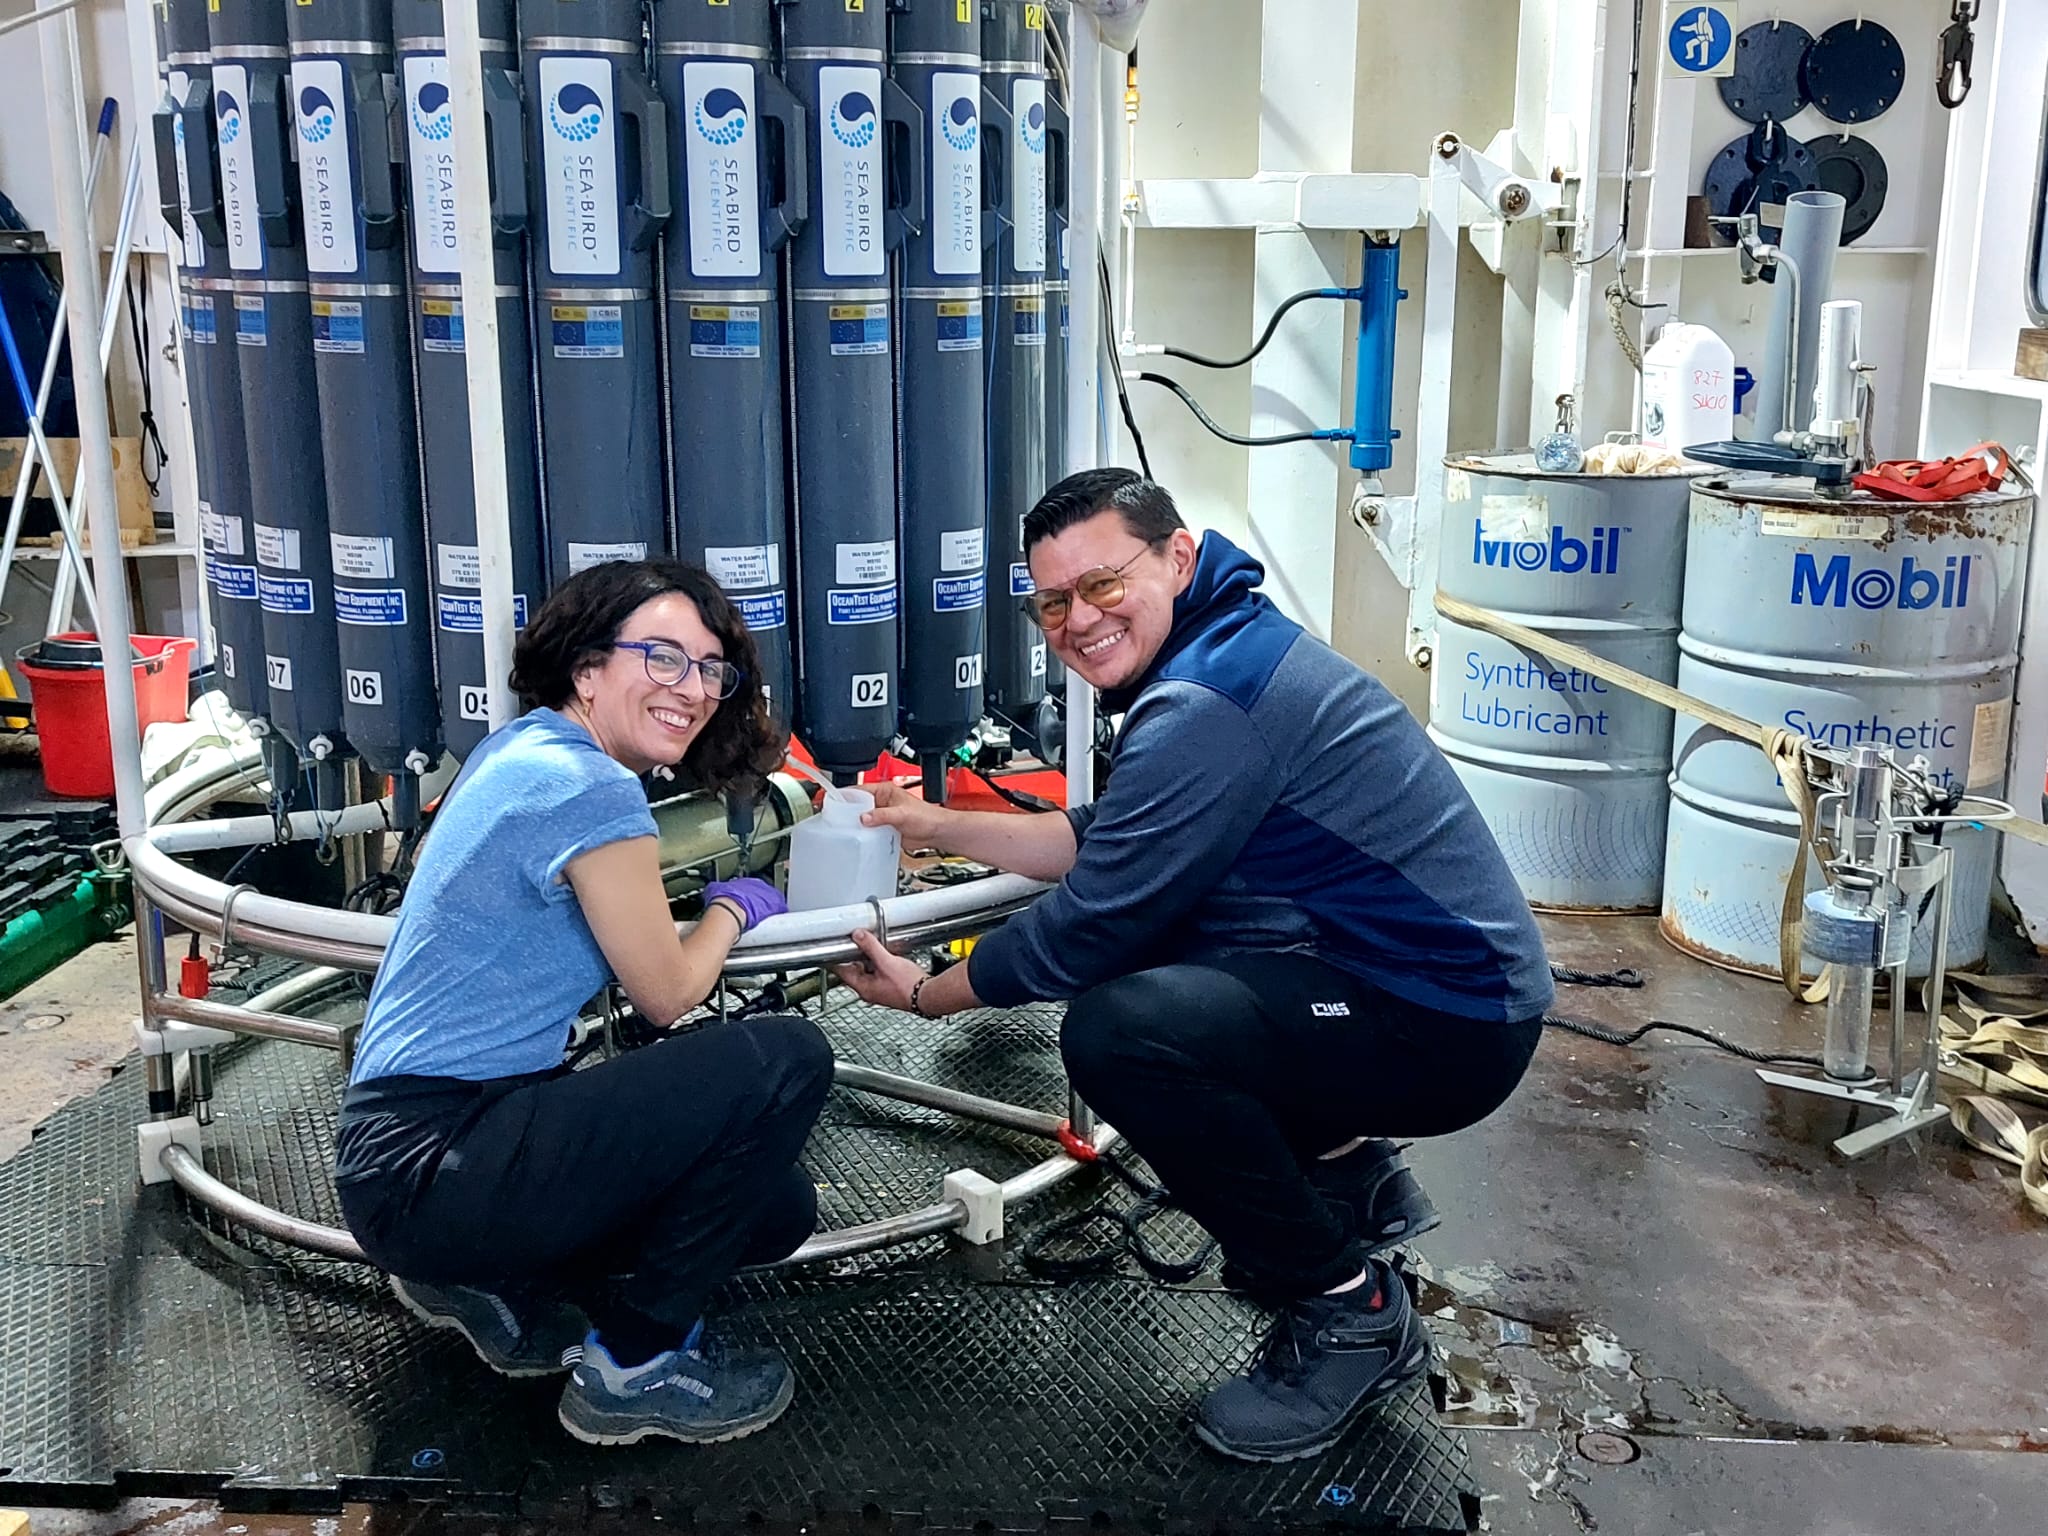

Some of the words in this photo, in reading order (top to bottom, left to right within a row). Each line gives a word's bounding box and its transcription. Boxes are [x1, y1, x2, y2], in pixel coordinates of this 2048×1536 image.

[1473, 518, 1620, 574] Mobil
[1790, 553, 1971, 610] Mobil
[267, 660, 286, 685] 07
[350, 675, 377, 700] 06
[856, 678, 884, 702] 02
[958, 656, 979, 683] 01
[1465, 651, 1608, 694] Synthetic
[1462, 691, 1609, 736] Lubricant
[1784, 709, 1957, 750] Synthetic
